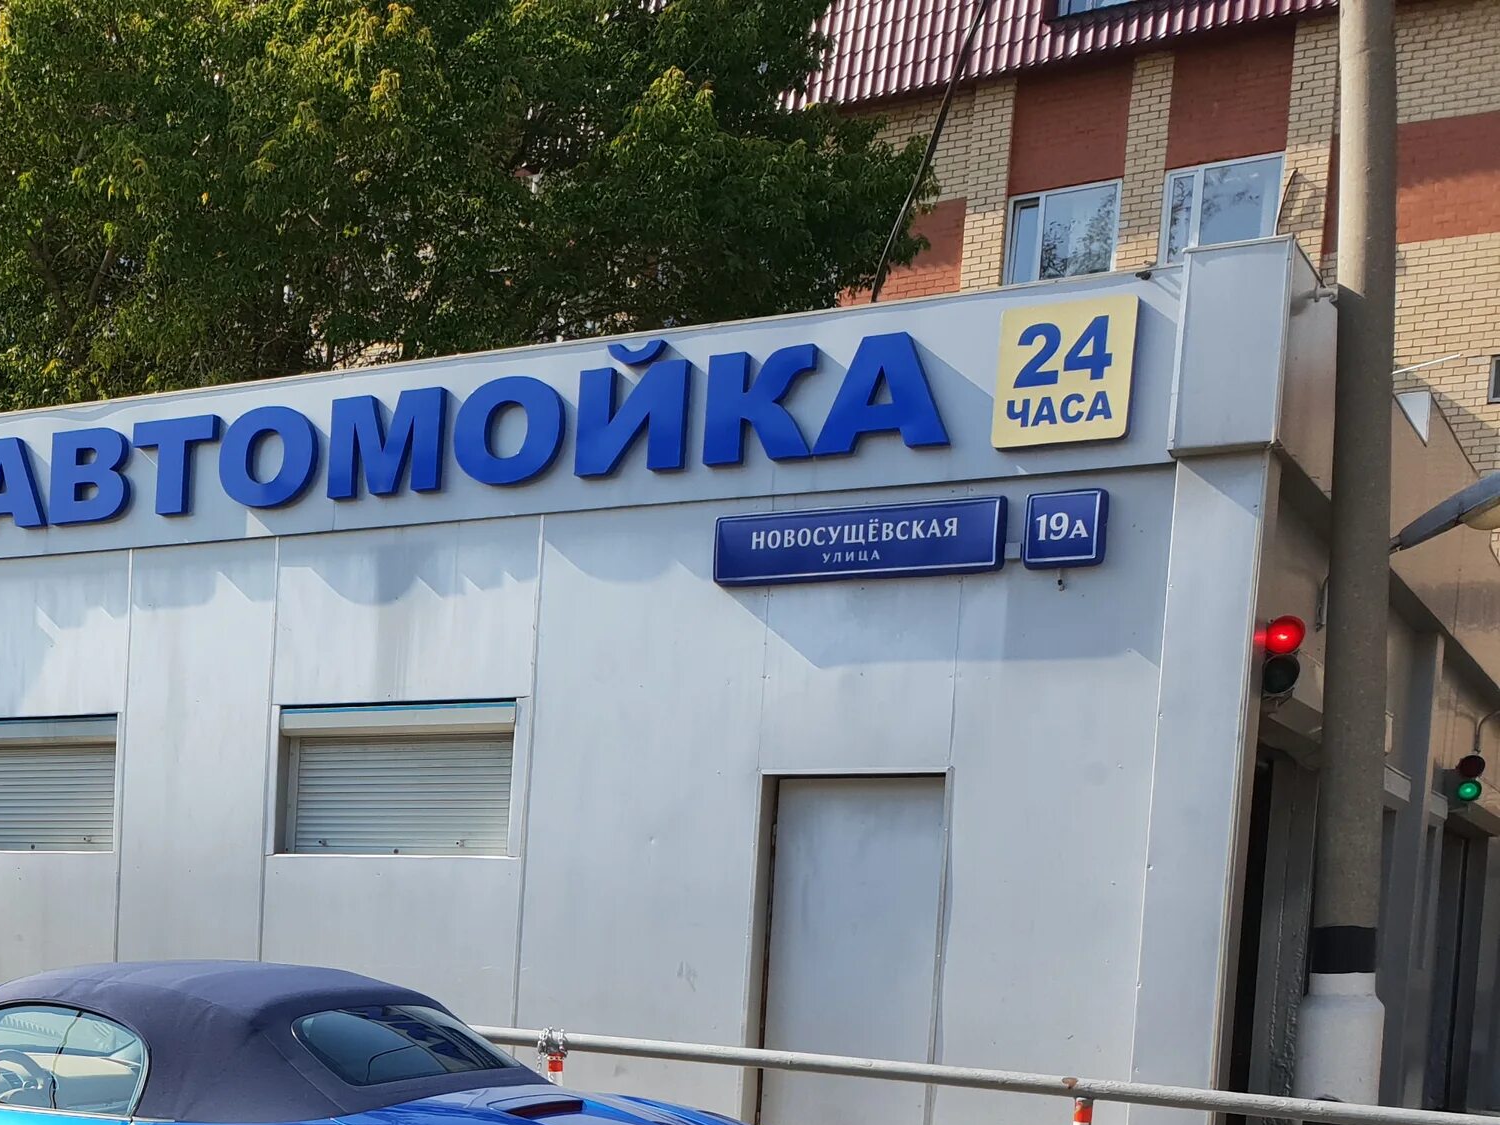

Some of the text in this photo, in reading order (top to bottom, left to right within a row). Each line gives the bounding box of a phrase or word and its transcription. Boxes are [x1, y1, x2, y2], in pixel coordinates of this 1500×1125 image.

[1013, 315, 1112, 389] 24
[1006, 390, 1112, 428] ЧАСА
[751, 516, 958, 550] НОВОСУЩЁВСКАЯ
[1035, 511, 1089, 542] 19А
[822, 549, 880, 564] УЛИЦА
